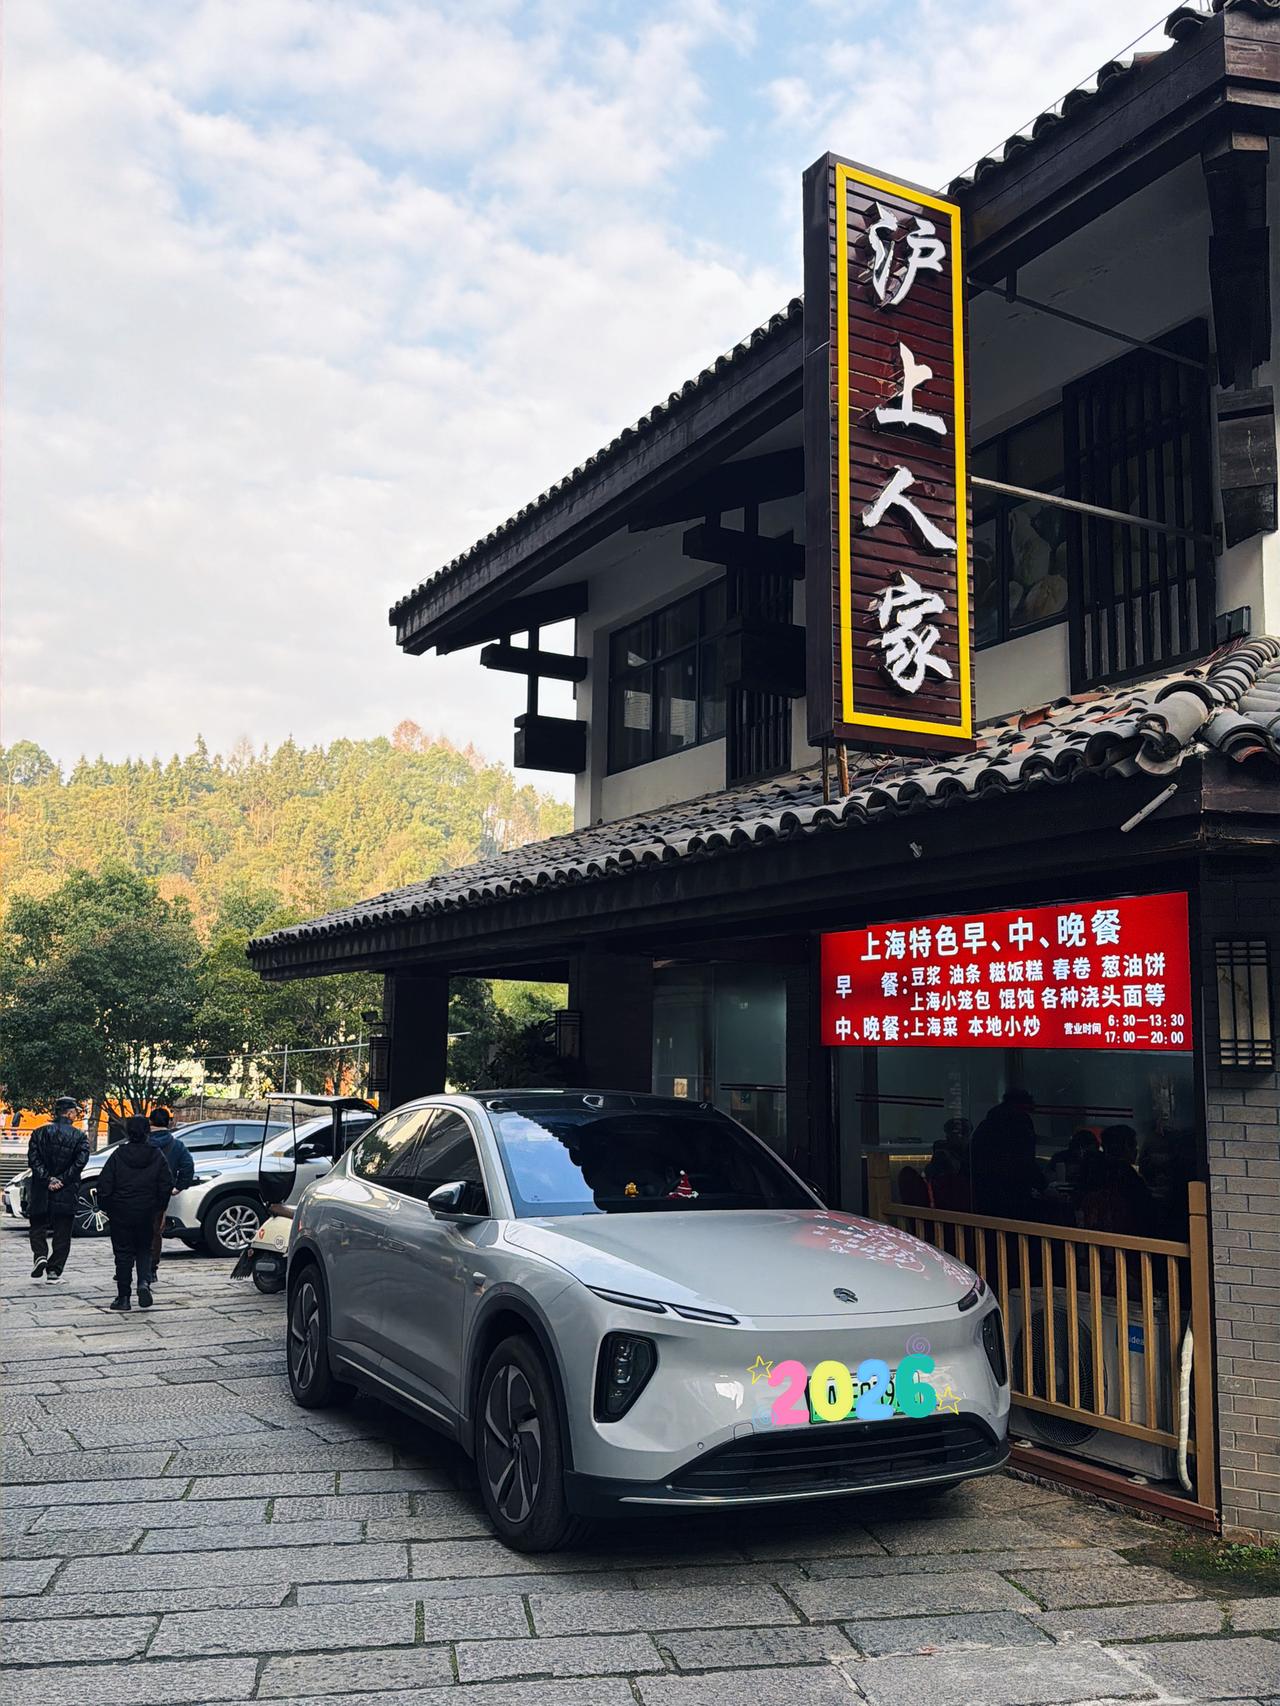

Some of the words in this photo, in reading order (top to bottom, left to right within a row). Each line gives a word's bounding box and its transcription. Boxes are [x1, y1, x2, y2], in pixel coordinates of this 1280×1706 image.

[862, 201, 958, 694] 沪上人家
[860, 908, 1122, 962] 上海特色早、中、晚餐
[949, 963, 981, 985] 油条
[1052, 956, 1091, 981] 春卷
[1101, 951, 1166, 978] 葱油饼
[910, 989, 991, 1011] 上海小笼包
[999, 987, 1035, 1010] 馄饨
[1041, 982, 1167, 1009] 各种浇头面等
[968, 1014, 1041, 1037] 本地小炒
[1064, 1022, 1102, 1035] 营业时间
